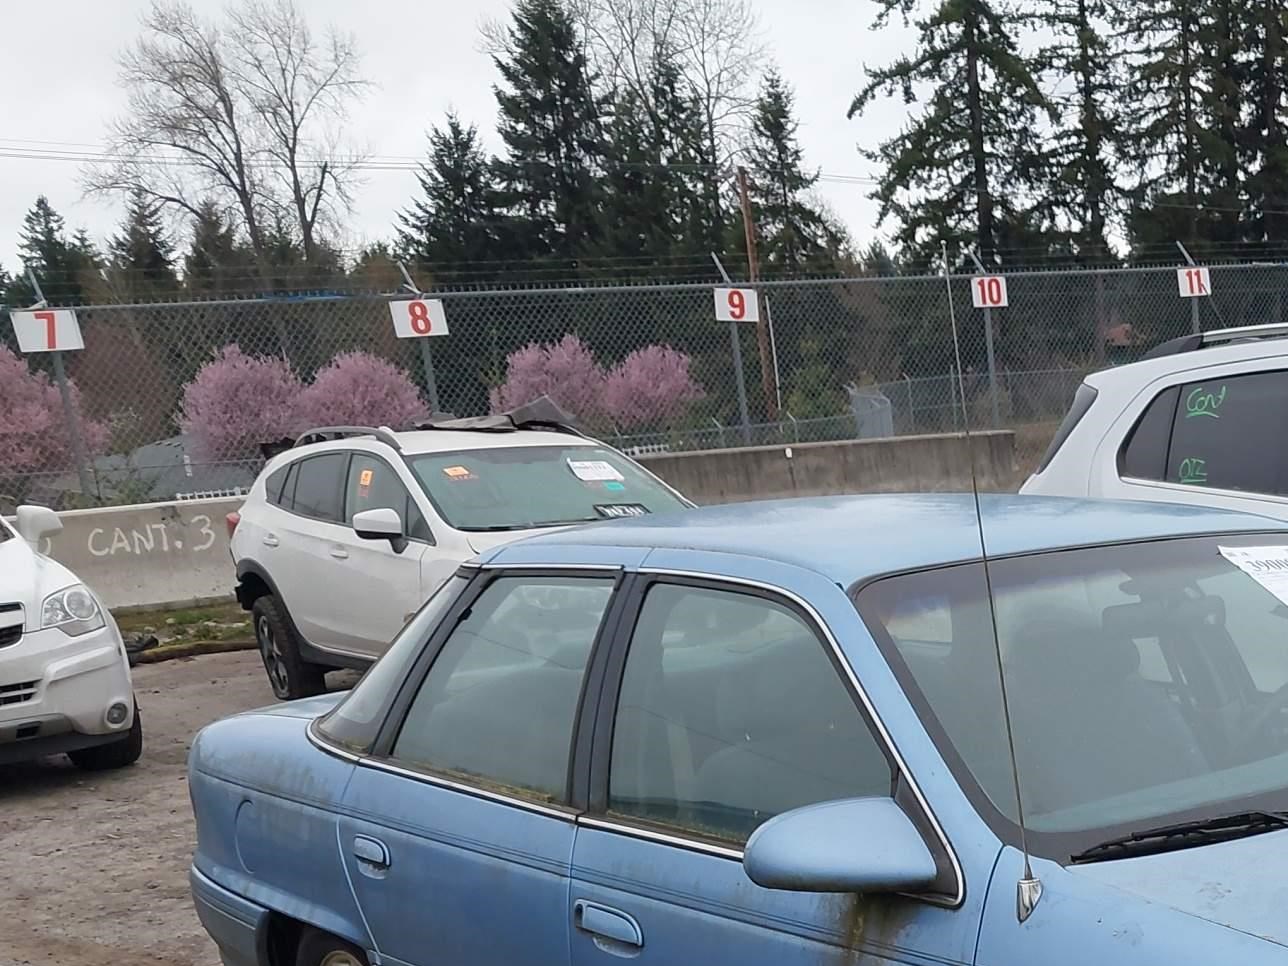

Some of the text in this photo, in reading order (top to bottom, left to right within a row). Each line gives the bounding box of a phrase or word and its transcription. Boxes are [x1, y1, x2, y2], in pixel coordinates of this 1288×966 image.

[977, 278, 1002, 305] 10
[1186, 270, 1203, 294] 11
[408, 301, 432, 334] 8
[727, 290, 745, 319] 9
[33, 312, 57, 349] 7
[88, 524, 183, 556] CANT.
[191, 515, 216, 552] 3
